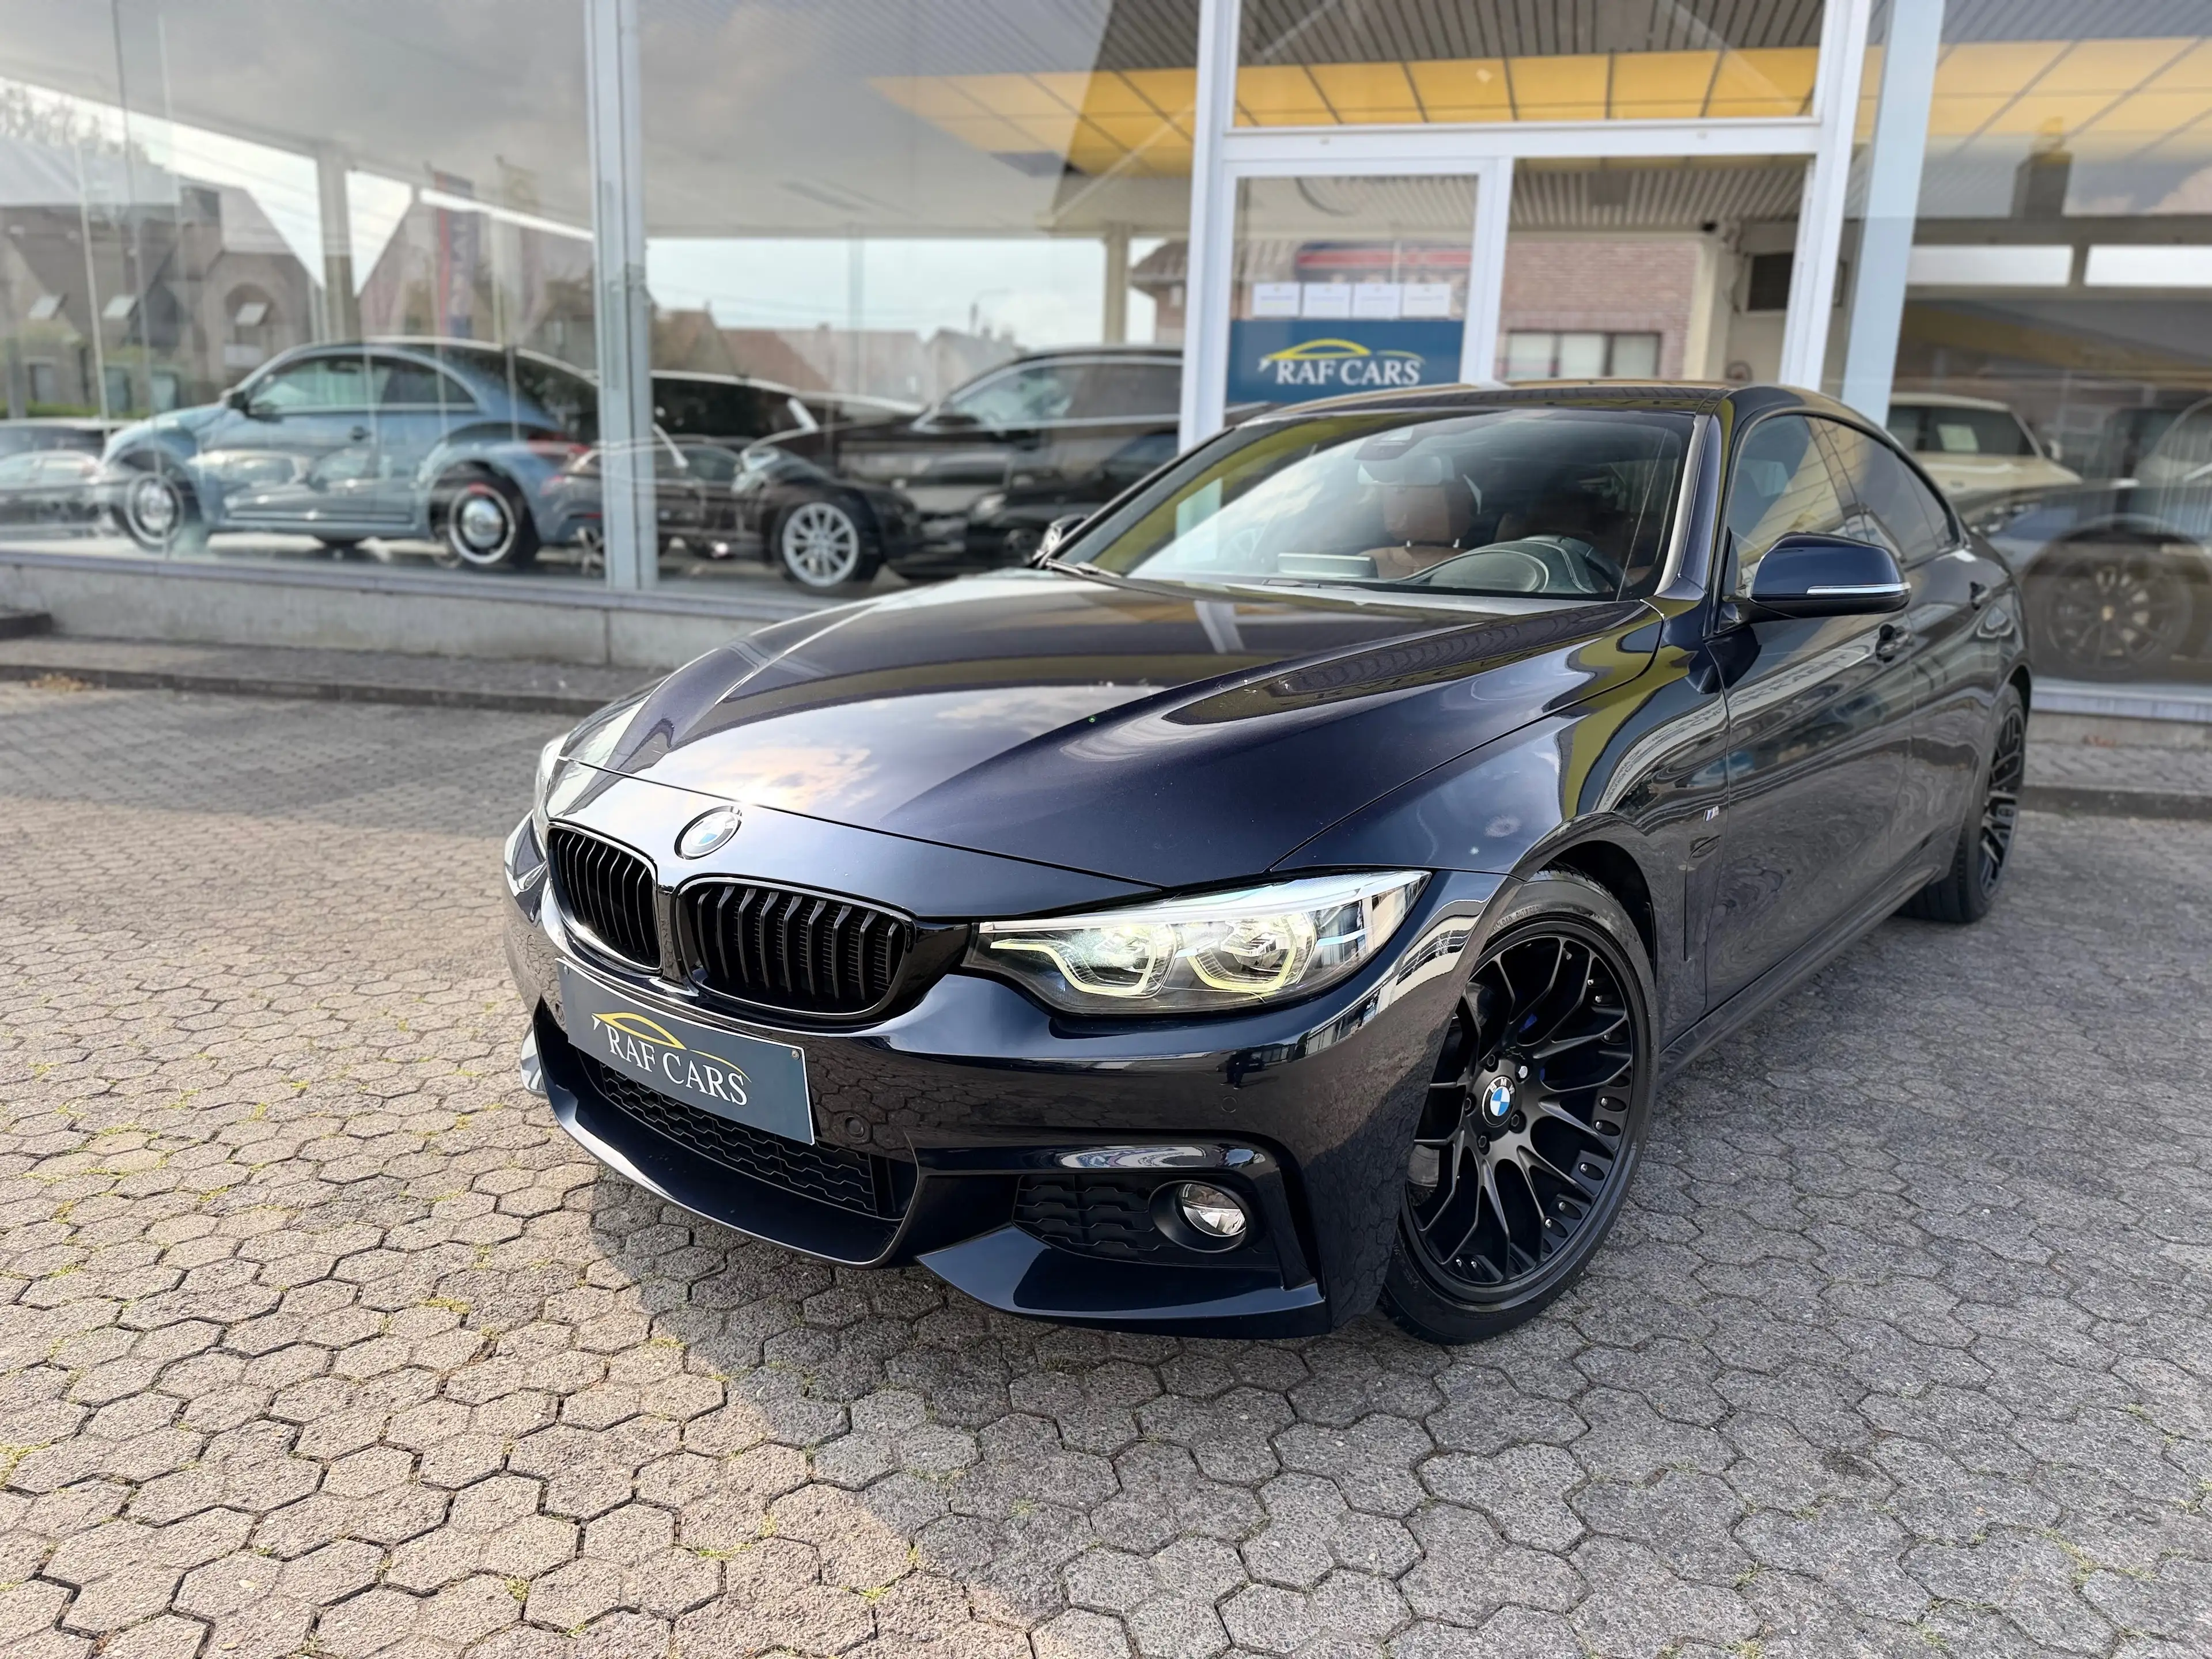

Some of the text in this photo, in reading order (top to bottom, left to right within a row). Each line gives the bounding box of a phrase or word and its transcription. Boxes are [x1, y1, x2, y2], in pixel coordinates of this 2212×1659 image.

[1275, 359, 1421, 386] RAF CARS
[604, 1023, 748, 1106] RAF CARS
[1489, 1077, 1516, 1094] BMW
